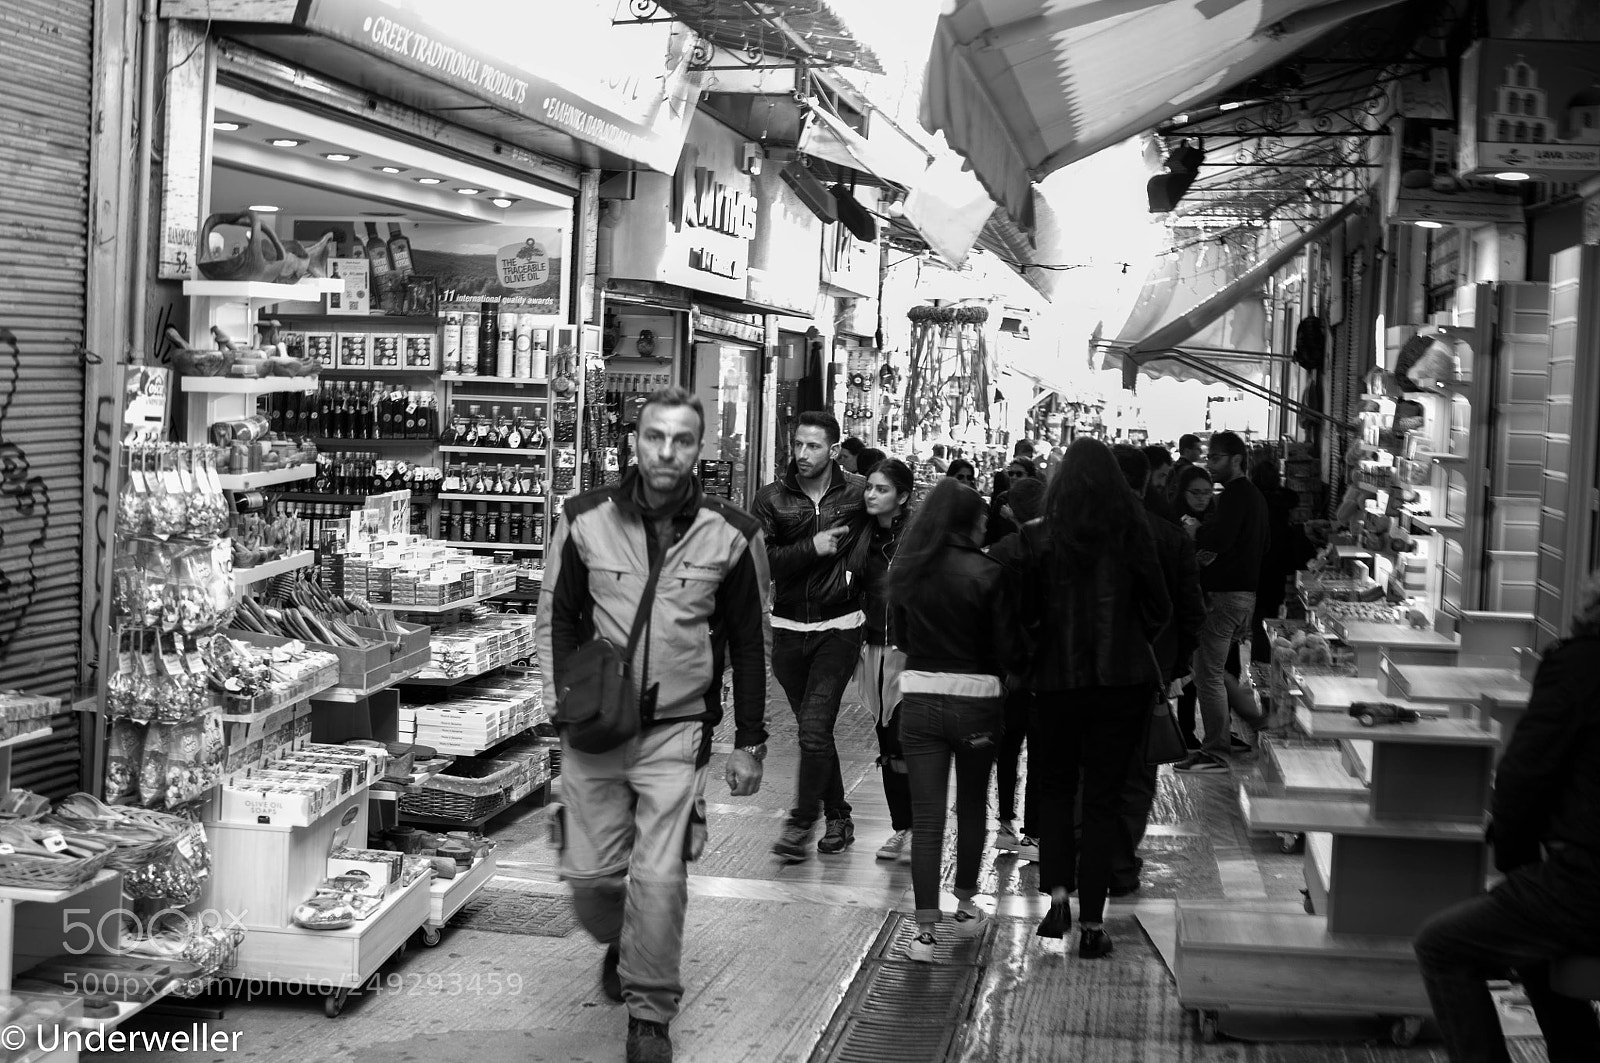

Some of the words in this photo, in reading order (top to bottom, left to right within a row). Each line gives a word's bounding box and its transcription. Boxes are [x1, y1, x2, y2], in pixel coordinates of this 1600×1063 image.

[371, 16, 414, 56] GREEK
[411, 33, 480, 84] TRADITIONAL
[479, 63, 529, 104] PRODUCTS
[175, 251, 188, 275] 53
[501, 258, 517, 267] THE
[502, 262, 546, 276] TRACEABLE
[504, 273, 526, 284] OLIVE
[527, 272, 540, 281] OIL
[443, 289, 456, 302] 11
[456, 293, 502, 304] international
[502, 295, 526, 306] quality
[527, 296, 554, 306] awards
[245, 800, 269, 808] OLIVE
[269, 801, 283, 809] OIL
[251, 807, 277, 815] SOAPS
